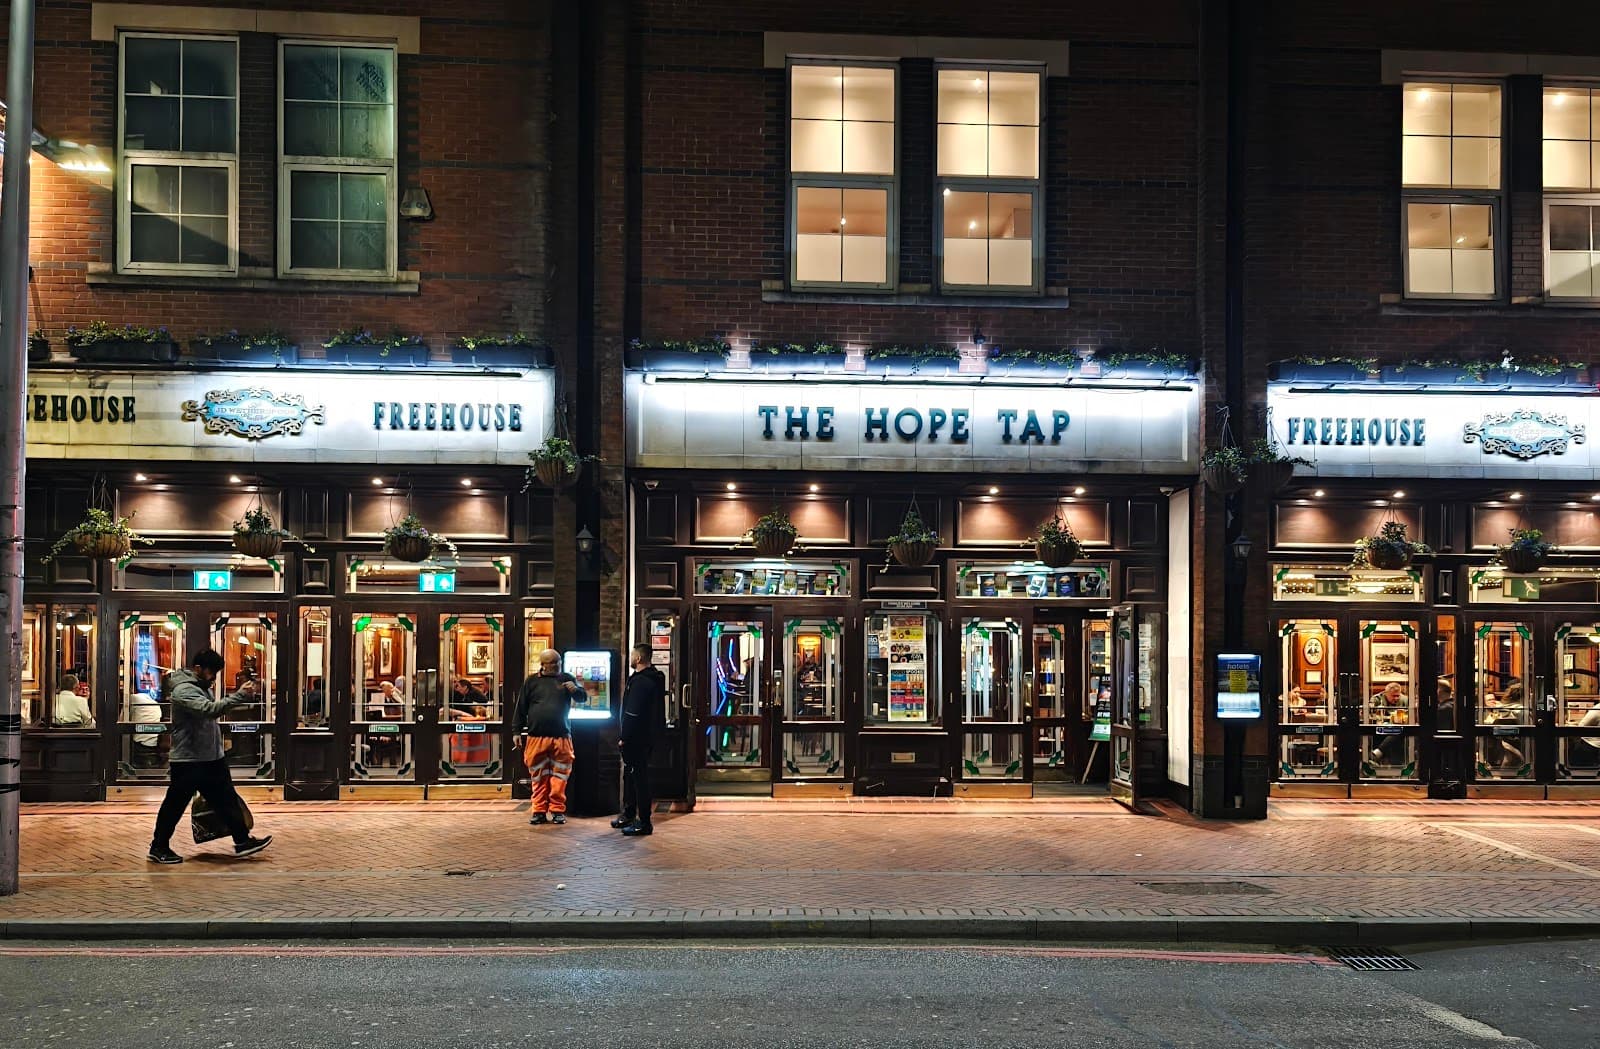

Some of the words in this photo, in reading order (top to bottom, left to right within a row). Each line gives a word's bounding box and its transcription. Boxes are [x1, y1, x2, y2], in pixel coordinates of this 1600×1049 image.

[27, 395, 136, 423] EHOUSE
[373, 401, 523, 431] FREEHOUSE
[758, 405, 835, 440] THE
[864, 407, 970, 442] HOPE
[997, 409, 1072, 444] TAP
[1288, 417, 1426, 446] FREEHOUSE
